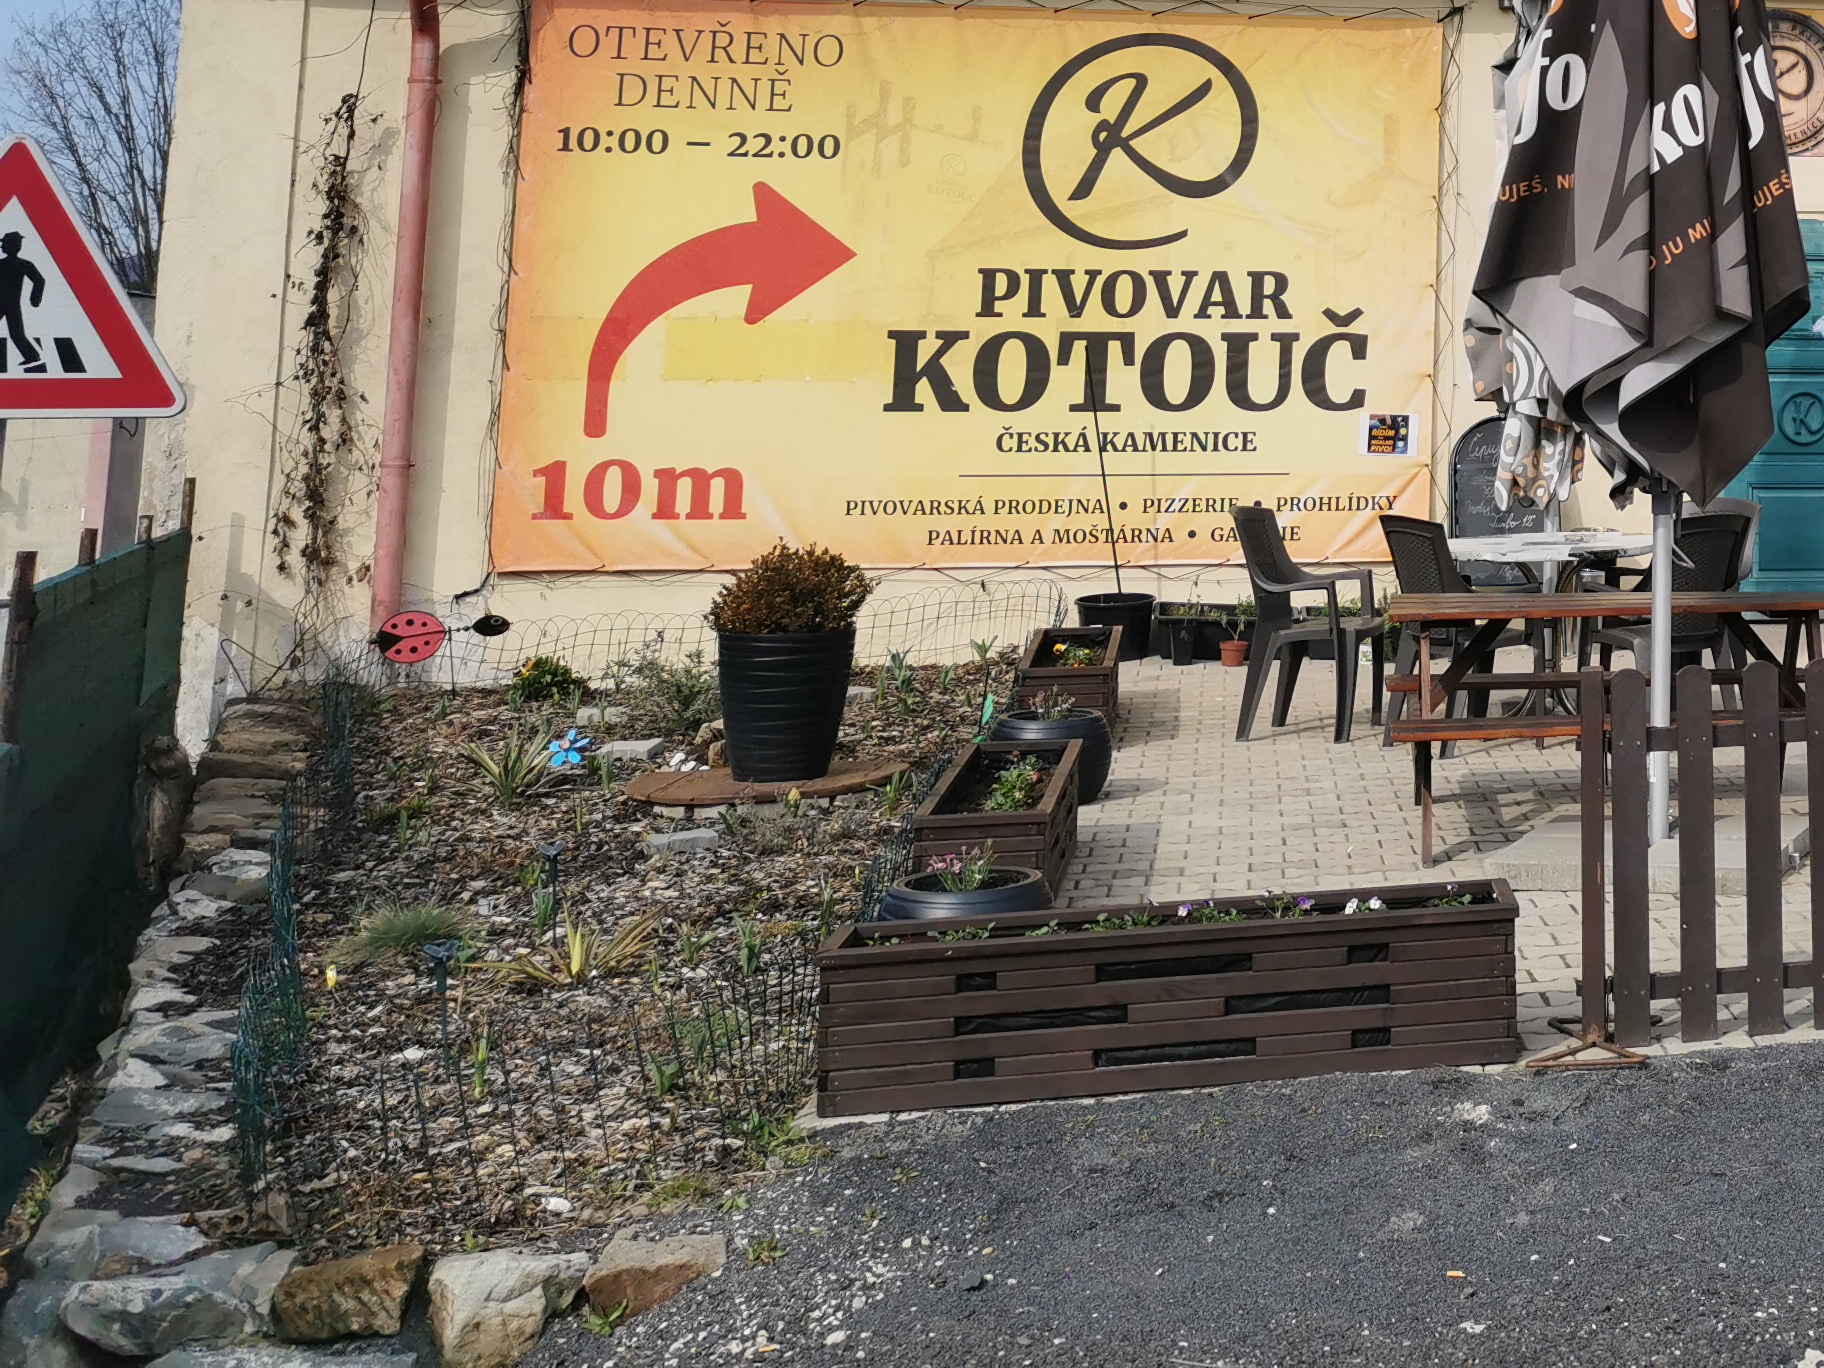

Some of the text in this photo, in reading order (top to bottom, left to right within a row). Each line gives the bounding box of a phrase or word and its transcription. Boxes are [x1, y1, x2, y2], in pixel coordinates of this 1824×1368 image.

[568, 20, 844, 67] OTEVŘENO
[614, 68, 793, 112] DENNĚ
[556, 126, 669, 155] 10:00
[727, 131, 841, 159] 22:00
[975, 267, 1293, 320] PIVOVAR
[883, 307, 1369, 413] KOTOUČ
[995, 426, 1257, 454] ČESKÁ KAMENICE
[531, 459, 747, 520] 10m
[845, 496, 986, 516] PIVOVARSKÁ
[993, 498, 1105, 517] PRODEJNA
[1276, 492, 1398, 513] PROHLÍDKY
[927, 523, 1301, 546] PALÍRNA A MOŠTÁRNA GAIE
